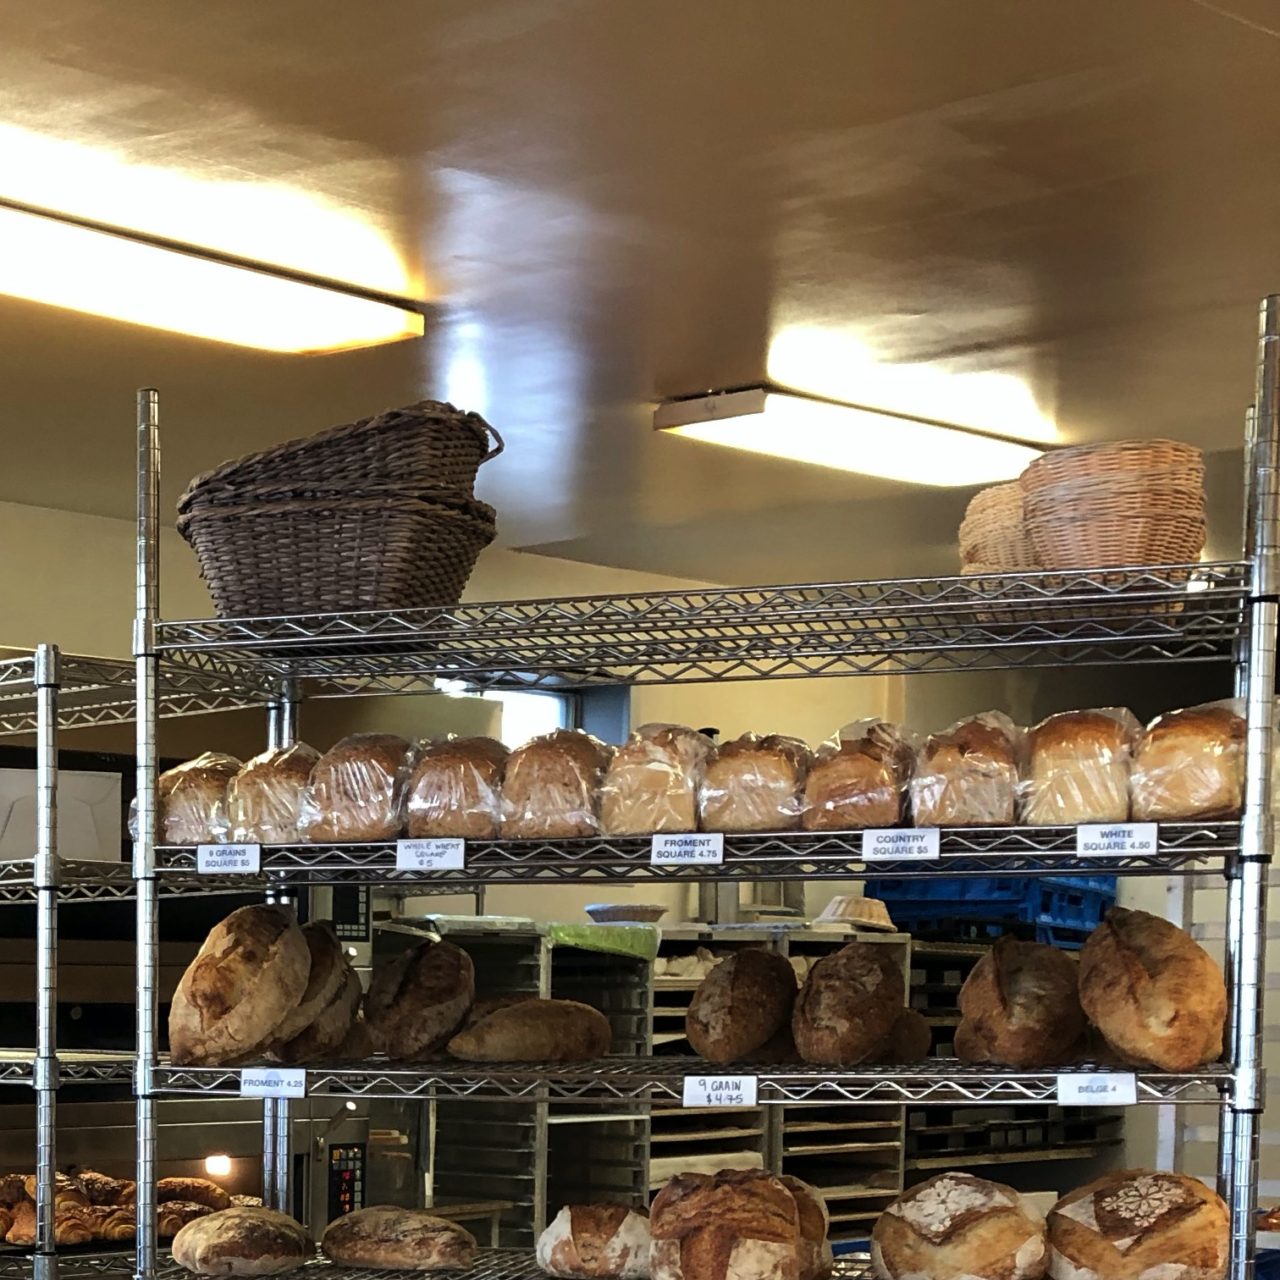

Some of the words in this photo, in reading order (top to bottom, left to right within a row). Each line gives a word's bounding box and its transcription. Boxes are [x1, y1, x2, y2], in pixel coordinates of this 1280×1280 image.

[1100, 830, 1133, 838] WHITE
[664, 839, 712, 847] FROMENT
[876, 835, 925, 843] COUNTRY
[1083, 842, 1127, 851] SQUARE
[1130, 841, 1150, 849] 4.50
[215, 849, 246, 857] GRAINS
[656, 850, 696, 858] SQUARE
[872, 846, 915, 855] SQUARE
[243, 1079, 284, 1087] FROMENT
[698, 1078, 707, 1092] 9
[711, 1080, 742, 1092] GRAIN
[1078, 1085, 1109, 1093] BELGE
